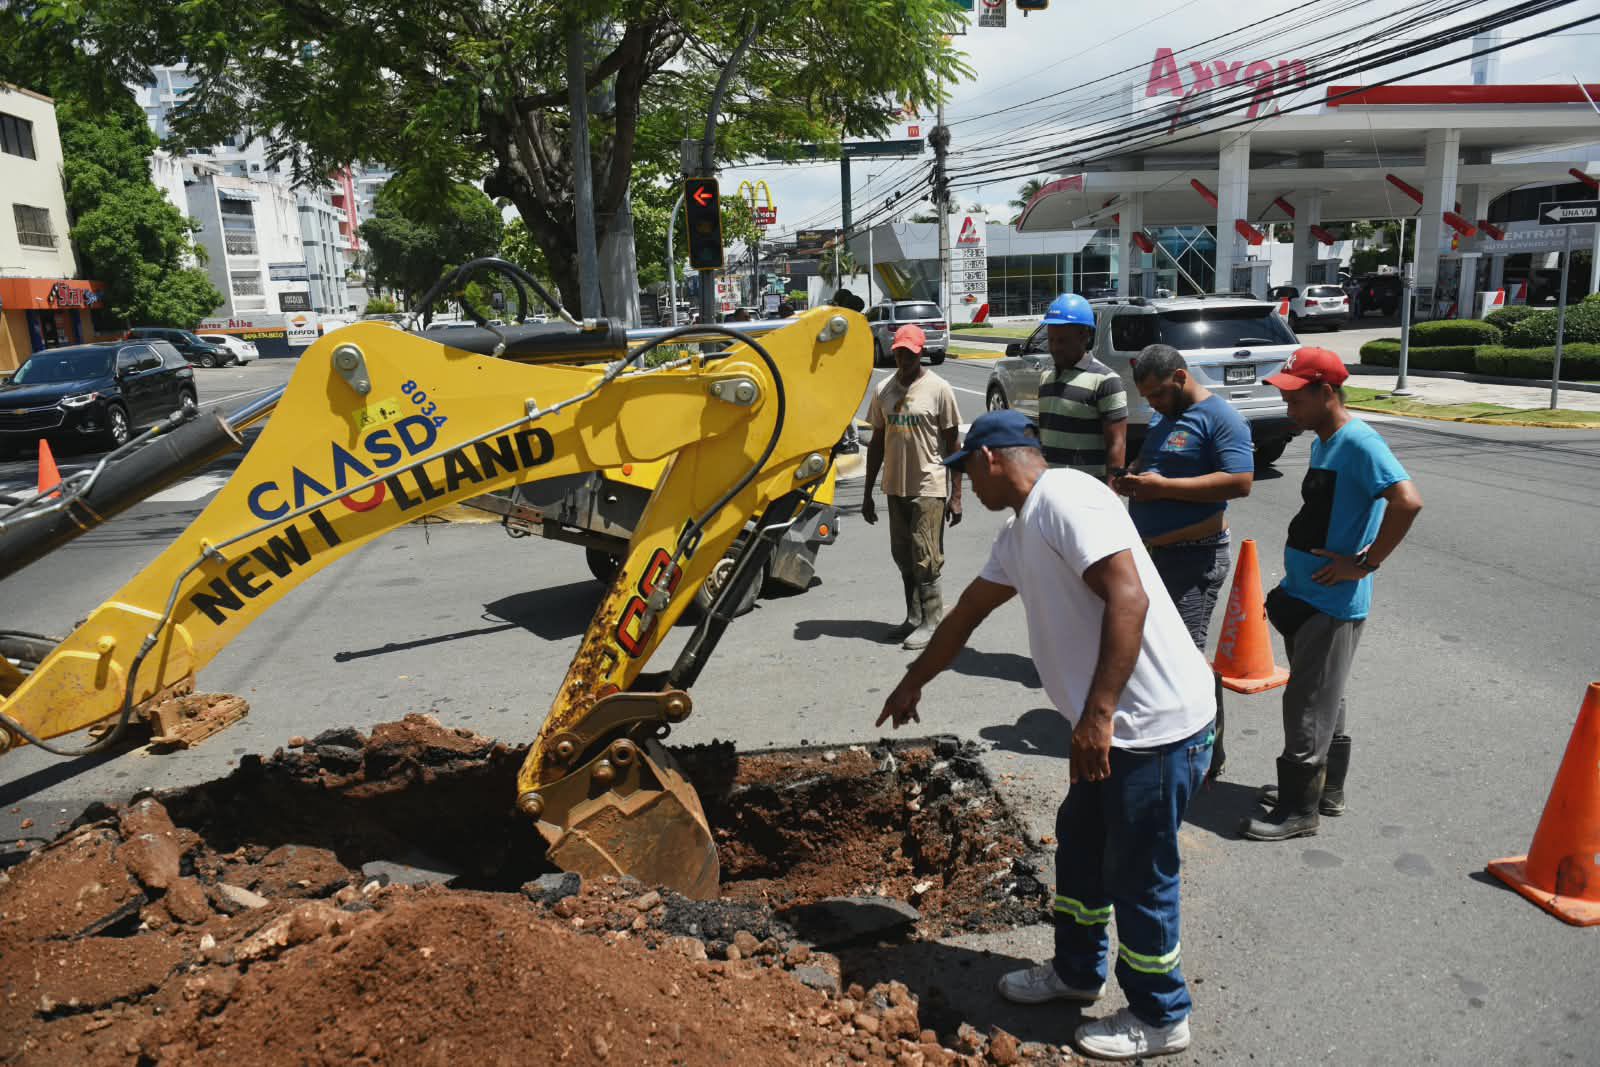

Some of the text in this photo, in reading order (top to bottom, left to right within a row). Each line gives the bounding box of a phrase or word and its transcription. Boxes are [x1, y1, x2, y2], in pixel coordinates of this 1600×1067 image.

[1562, 208, 1594, 217] UNA VIA
[228, 318, 253, 329] Alba
[288, 329, 315, 338] REPSOL
[401, 379, 448, 429] 8034
[248, 414, 437, 521] CAASD
[189, 523, 312, 626] NEW
